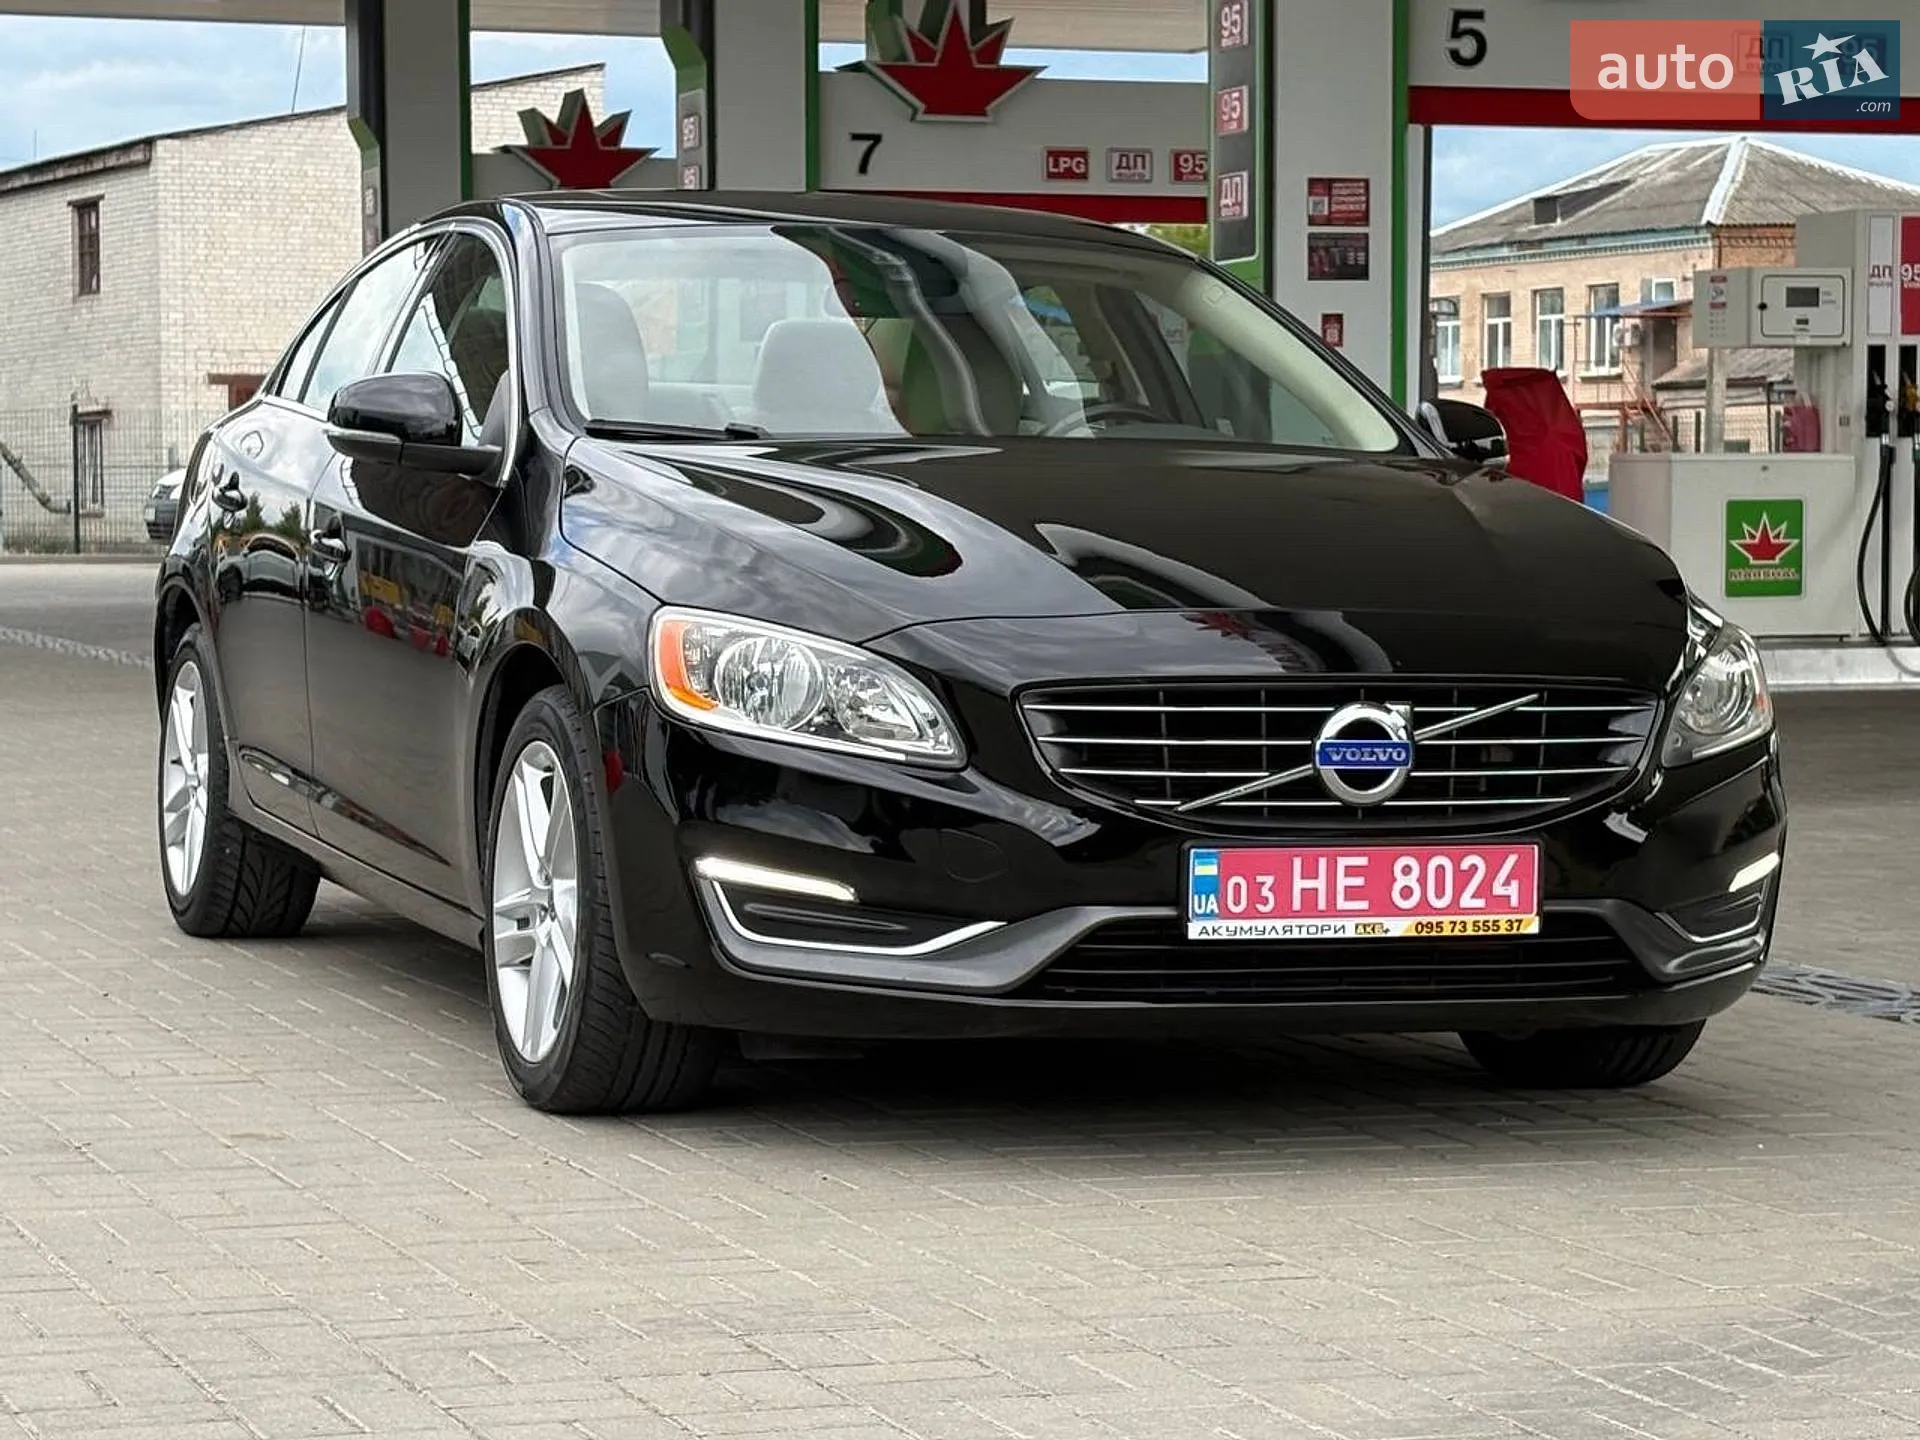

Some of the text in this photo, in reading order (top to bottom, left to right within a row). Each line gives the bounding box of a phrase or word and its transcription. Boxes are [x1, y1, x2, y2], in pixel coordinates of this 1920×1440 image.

[1221, 4, 1242, 37] 95
[1448, 9, 1487, 67] 5
[1221, 92, 1241, 121] 95
[849, 132, 882, 175] 7
[1115, 154, 1146, 171] ДП
[1179, 154, 1208, 174] 95
[1048, 157, 1087, 174] LPG
[1220, 177, 1242, 207] ДП
[1869, 264, 1893, 278] ДП
[1325, 747, 1407, 762] VOLVO
[1226, 875, 1276, 914] 03
[1391, 853, 1520, 910] 8024
[1193, 893, 1220, 915] UA
[1198, 923, 1346, 937] АКУМУЛЯТОРИ
[1414, 920, 1444, 935] 095
[1450, 921, 1467, 934] 73
[1471, 919, 1501, 933] 555
[1504, 919, 1524, 933] 37
